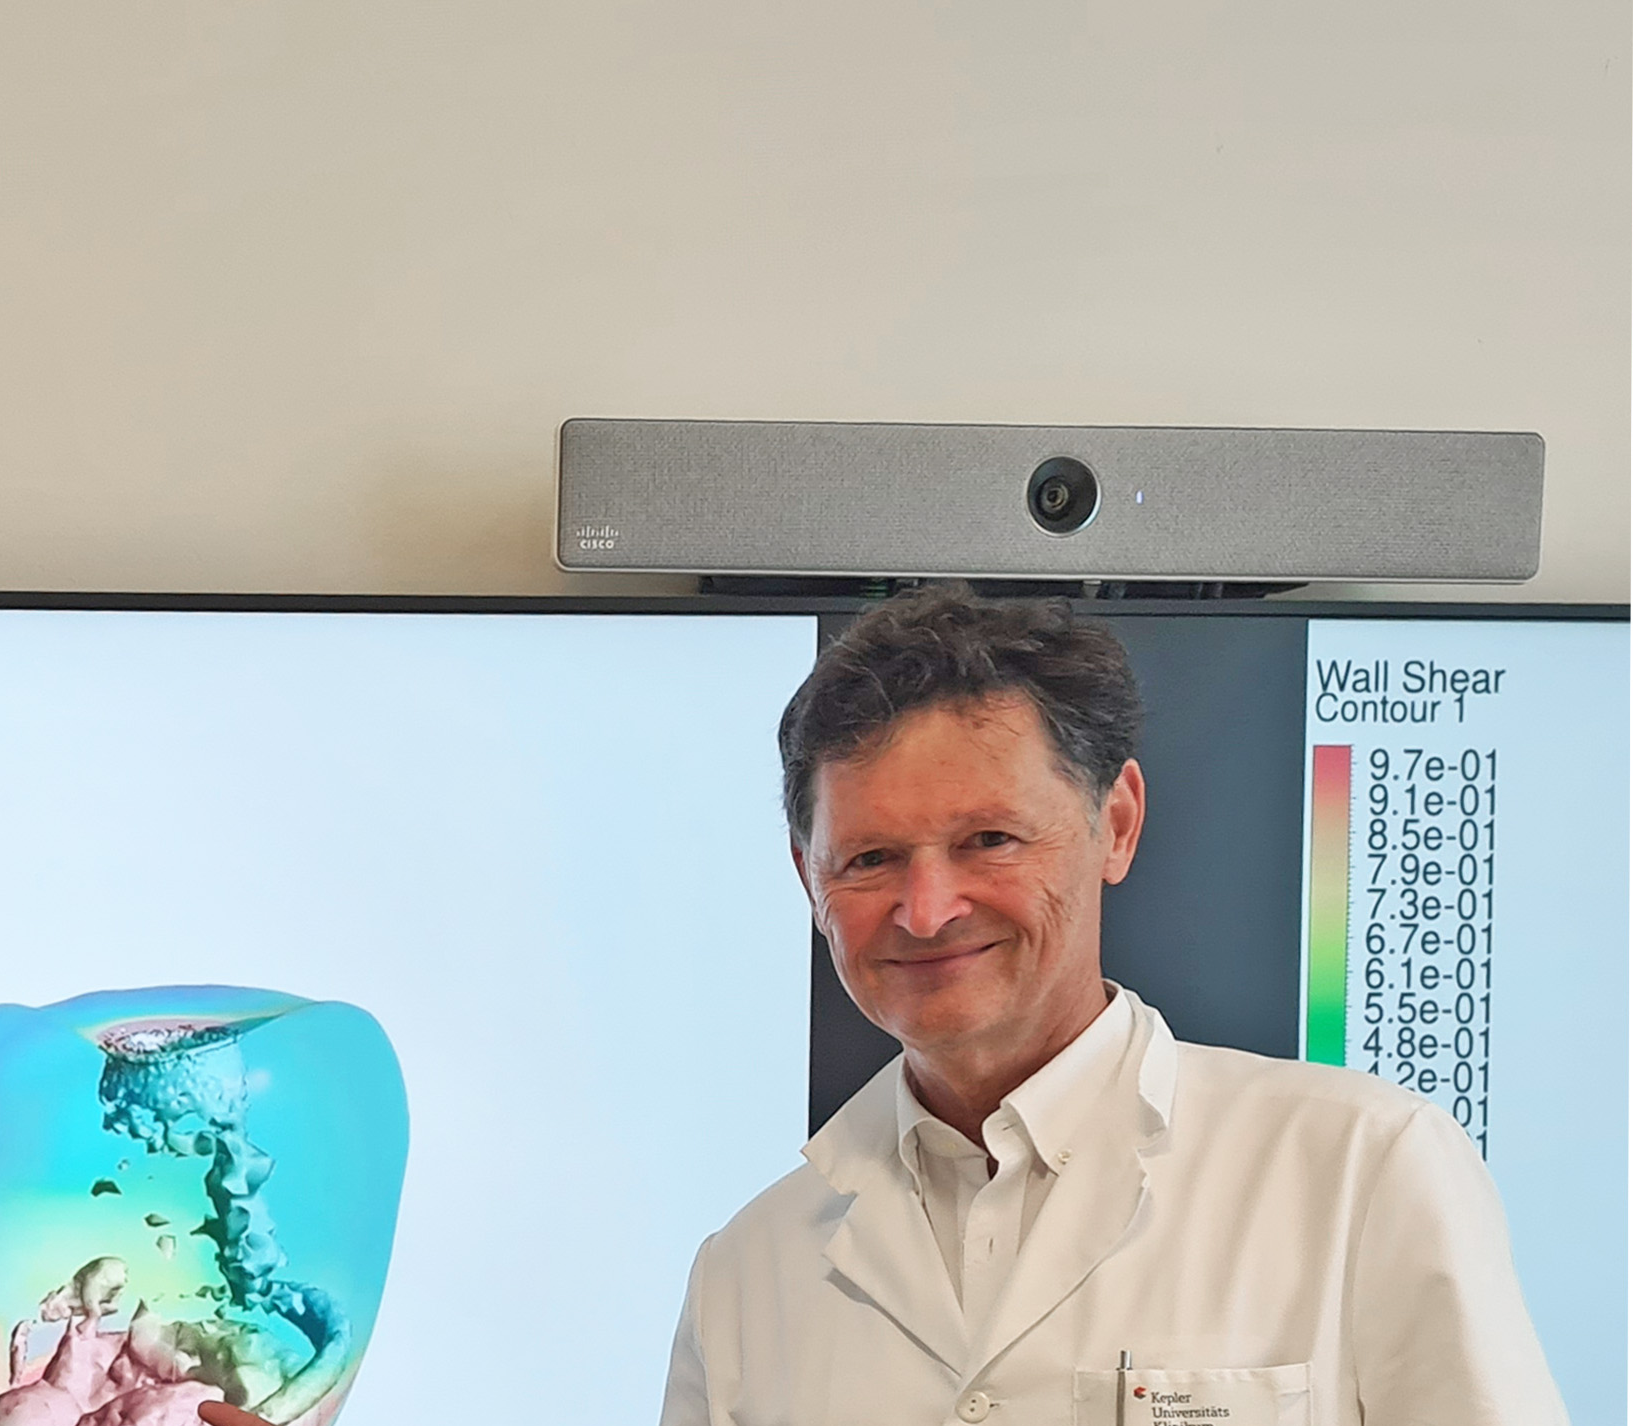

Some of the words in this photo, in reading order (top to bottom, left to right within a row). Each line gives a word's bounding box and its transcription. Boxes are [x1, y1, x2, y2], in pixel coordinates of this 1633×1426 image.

[1316, 660, 1388, 692] Wall
[1402, 660, 1505, 693] Shear
[1315, 692, 1441, 723] Contour
[1453, 694, 1465, 723] 1
[1370, 749, 1495, 781] 9.7e-01
[1369, 784, 1494, 816] 9.1e-01
[1368, 819, 1494, 851] 8.5e-01
[1367, 854, 1493, 885] 7.9e-01
[1366, 889, 1492, 920] 7.3e-01
[1365, 923, 1491, 954] 6.7e-01
[1365, 958, 1490, 989] 6.1e-01
[1364, 993, 1490, 1024] 5.5e-01
[1363, 1027, 1489, 1058] 4.8e-01
[1151, 1391, 1192, 1406] Kepler
[1152, 1406, 1230, 1419] Universitäts
